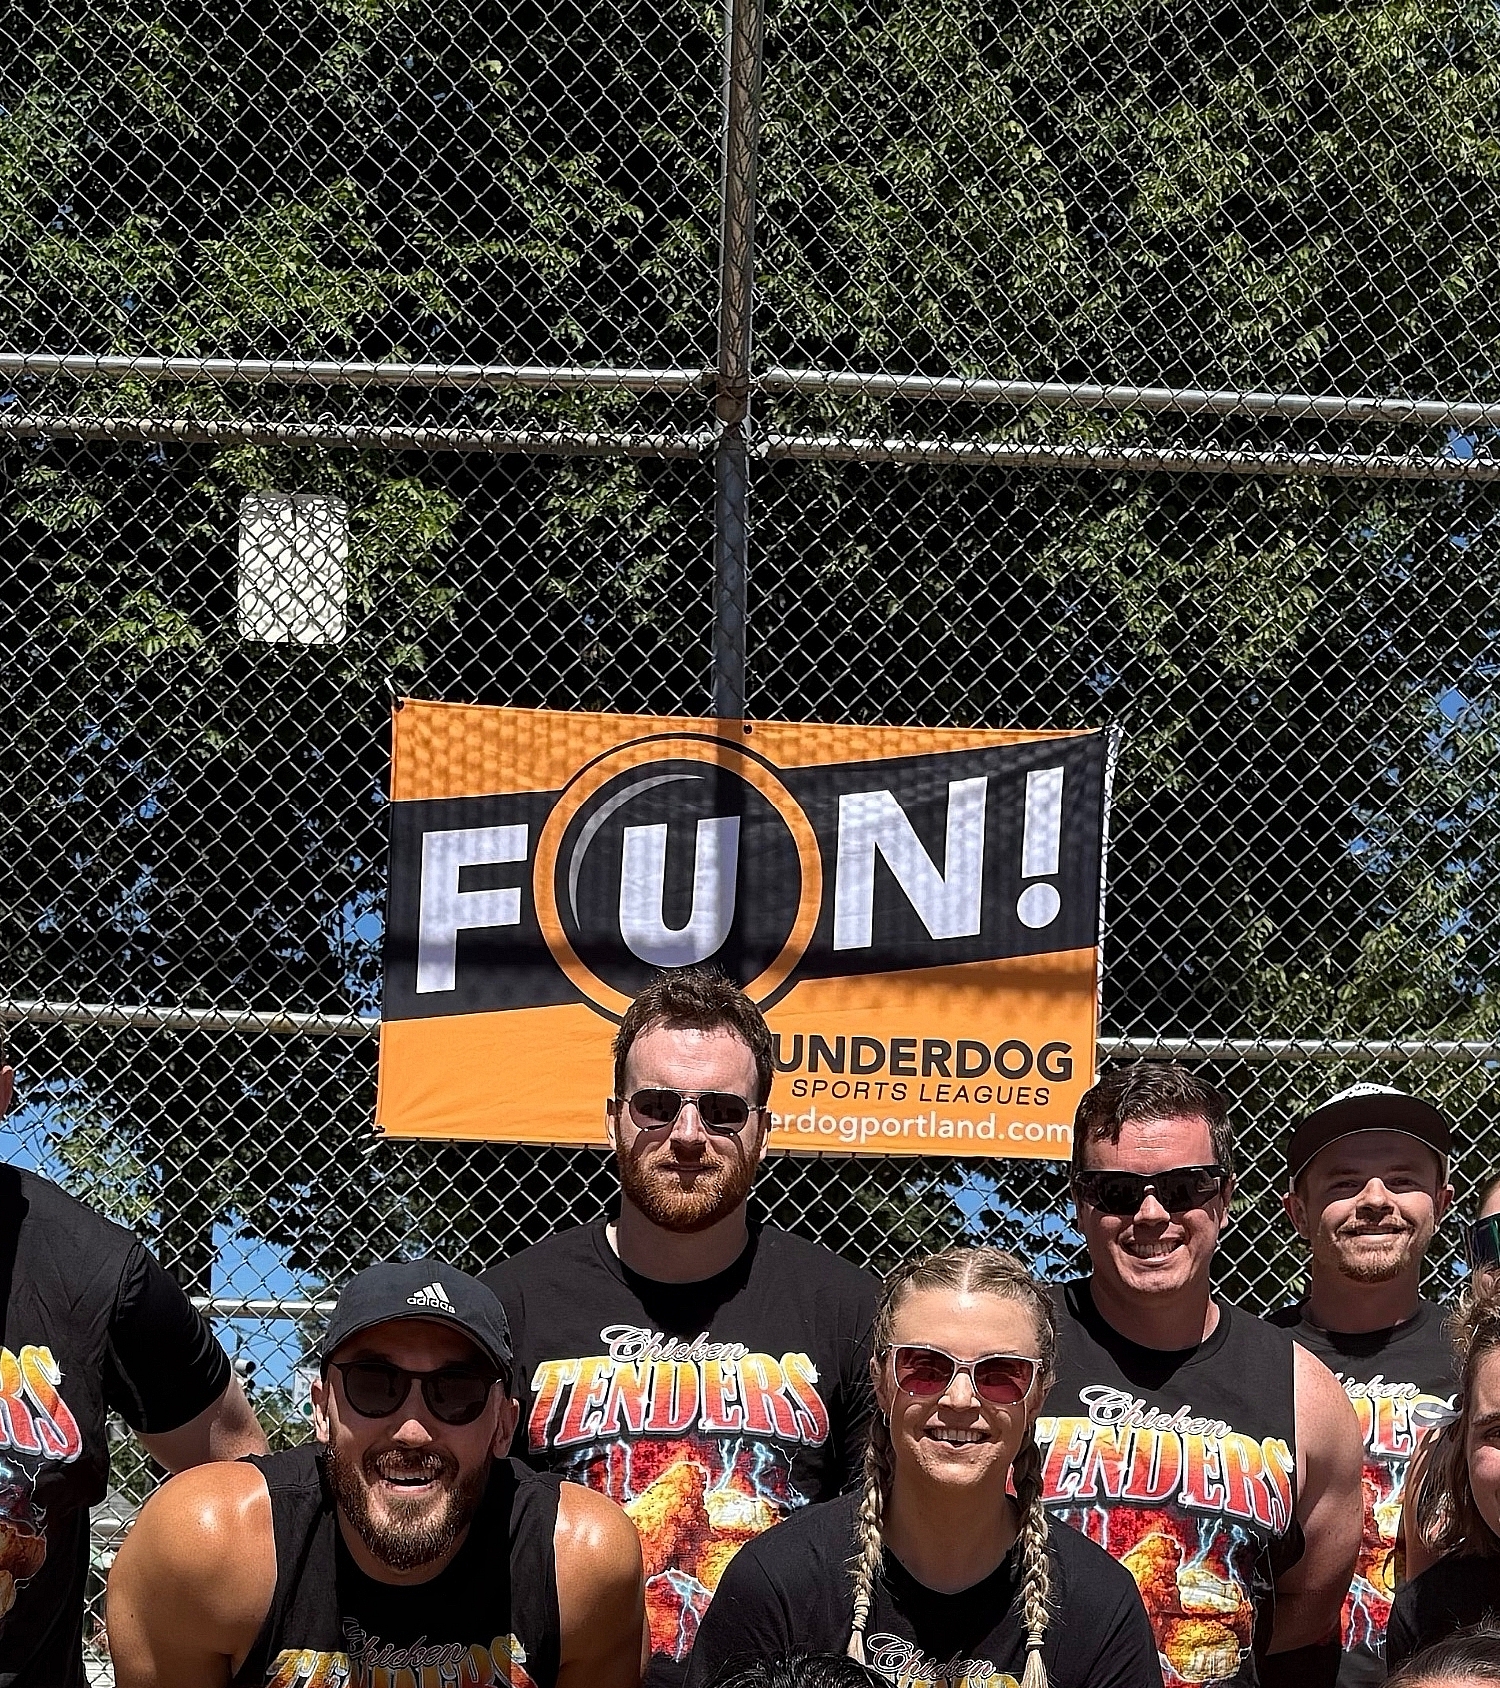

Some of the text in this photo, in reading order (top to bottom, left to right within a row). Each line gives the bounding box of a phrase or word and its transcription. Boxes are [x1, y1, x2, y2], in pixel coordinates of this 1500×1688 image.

[416, 766, 1064, 994] FUN!
[772, 1033, 1073, 1082] UNDERDOG
[791, 1079, 1050, 1106] SPORTS LEAGUES
[770, 1106, 1073, 1144] erdogportland.com
[406, 1295, 456, 1314] adidas
[600, 1324, 750, 1363] Chicken
[528, 1352, 830, 1454] TENDERS
[1080, 1385, 1232, 1438] Chicken
[342, 1616, 468, 1668] Chicken
[867, 1633, 997, 1680] Chicken
